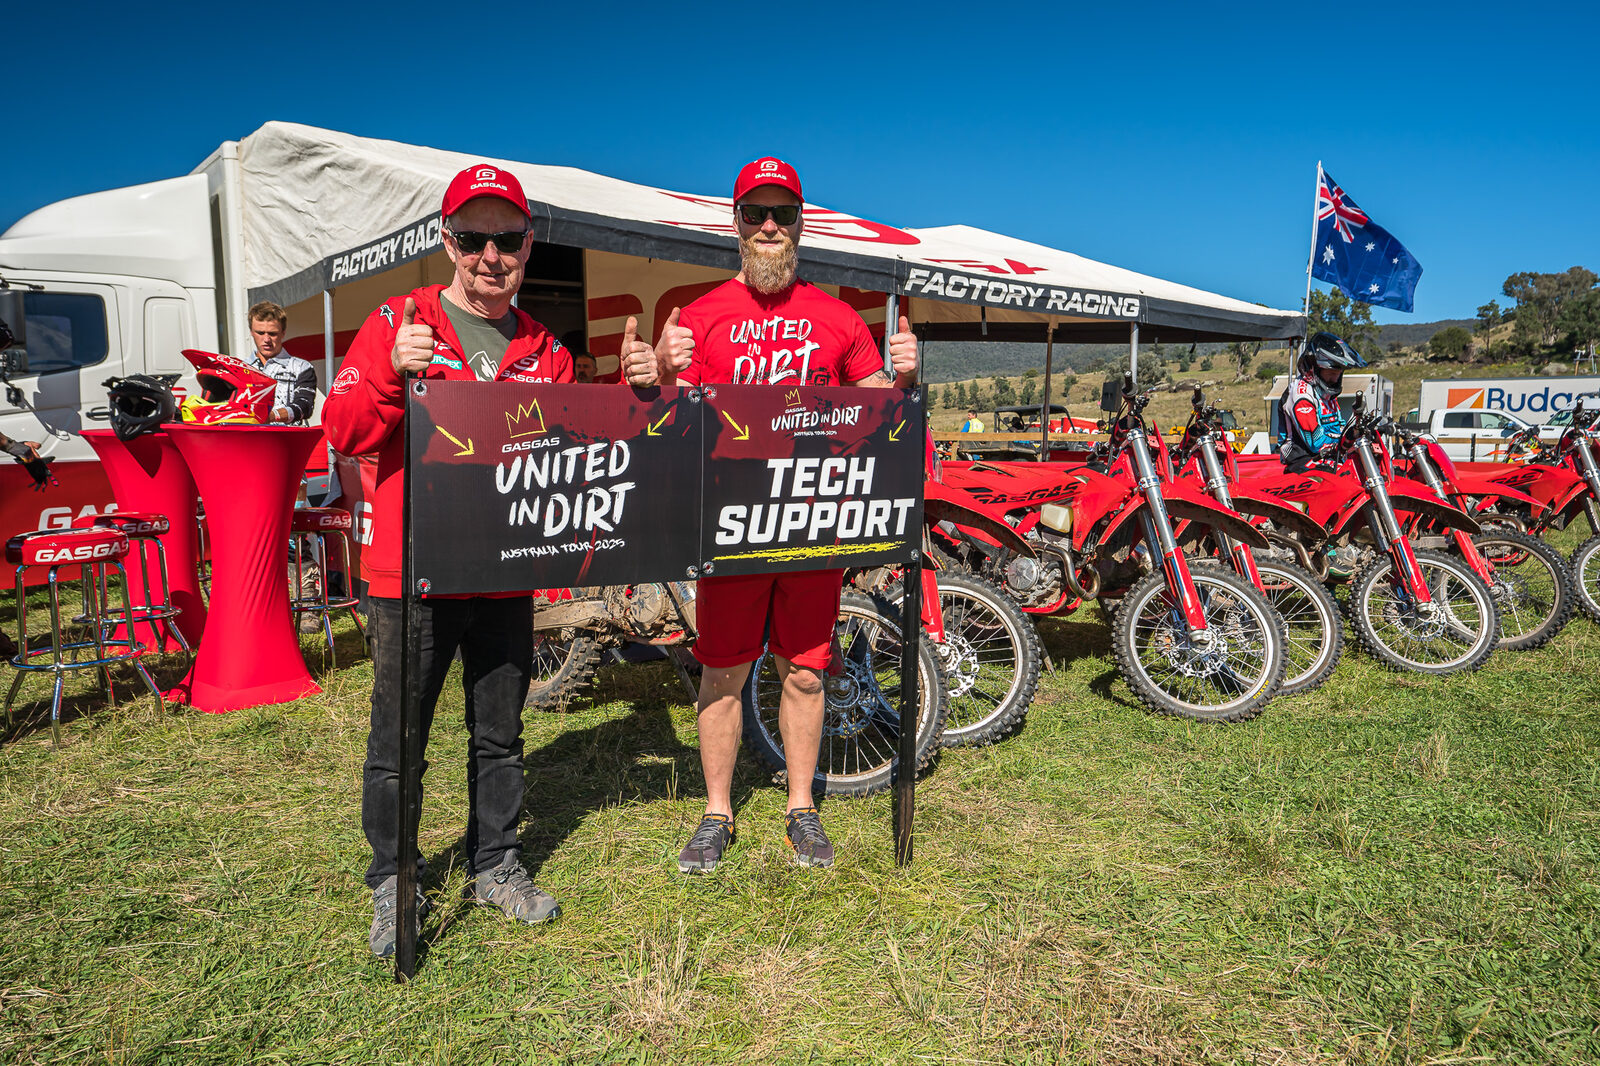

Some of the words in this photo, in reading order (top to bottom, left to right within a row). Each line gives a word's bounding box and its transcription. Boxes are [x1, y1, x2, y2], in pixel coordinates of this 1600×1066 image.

[470, 182, 508, 191] GASGAS
[755, 172, 787, 181] GASGAS
[331, 234, 402, 282] FACTORY
[402, 216, 444, 259] RACI
[904, 268, 1045, 309] FACTORY
[1046, 289, 1140, 317] RACING
[730, 315, 812, 344] UNITED
[433, 355, 461, 369] TOREX
[732, 339, 820, 386] DIRT
[747, 343, 761, 357] IN
[501, 370, 553, 384] GASGAS
[1487, 387, 1595, 421] Budg
[771, 411, 819, 431] UNITED
[820, 413, 830, 423] IN
[831, 405, 862, 426] DIRT
[501, 437, 560, 453] GASGAS
[495, 440, 631, 494] UNITED
[767, 457, 875, 498] TECH
[973, 481, 1081, 504] GASGAS
[509, 496, 540, 526] IN
[543, 482, 636, 537] DIRT
[715, 498, 915, 545] SUPPORT
[500, 545, 559, 561] AUSTRALIA
[560, 541, 593, 553] TOUR
[594, 538, 626, 551] 2025
